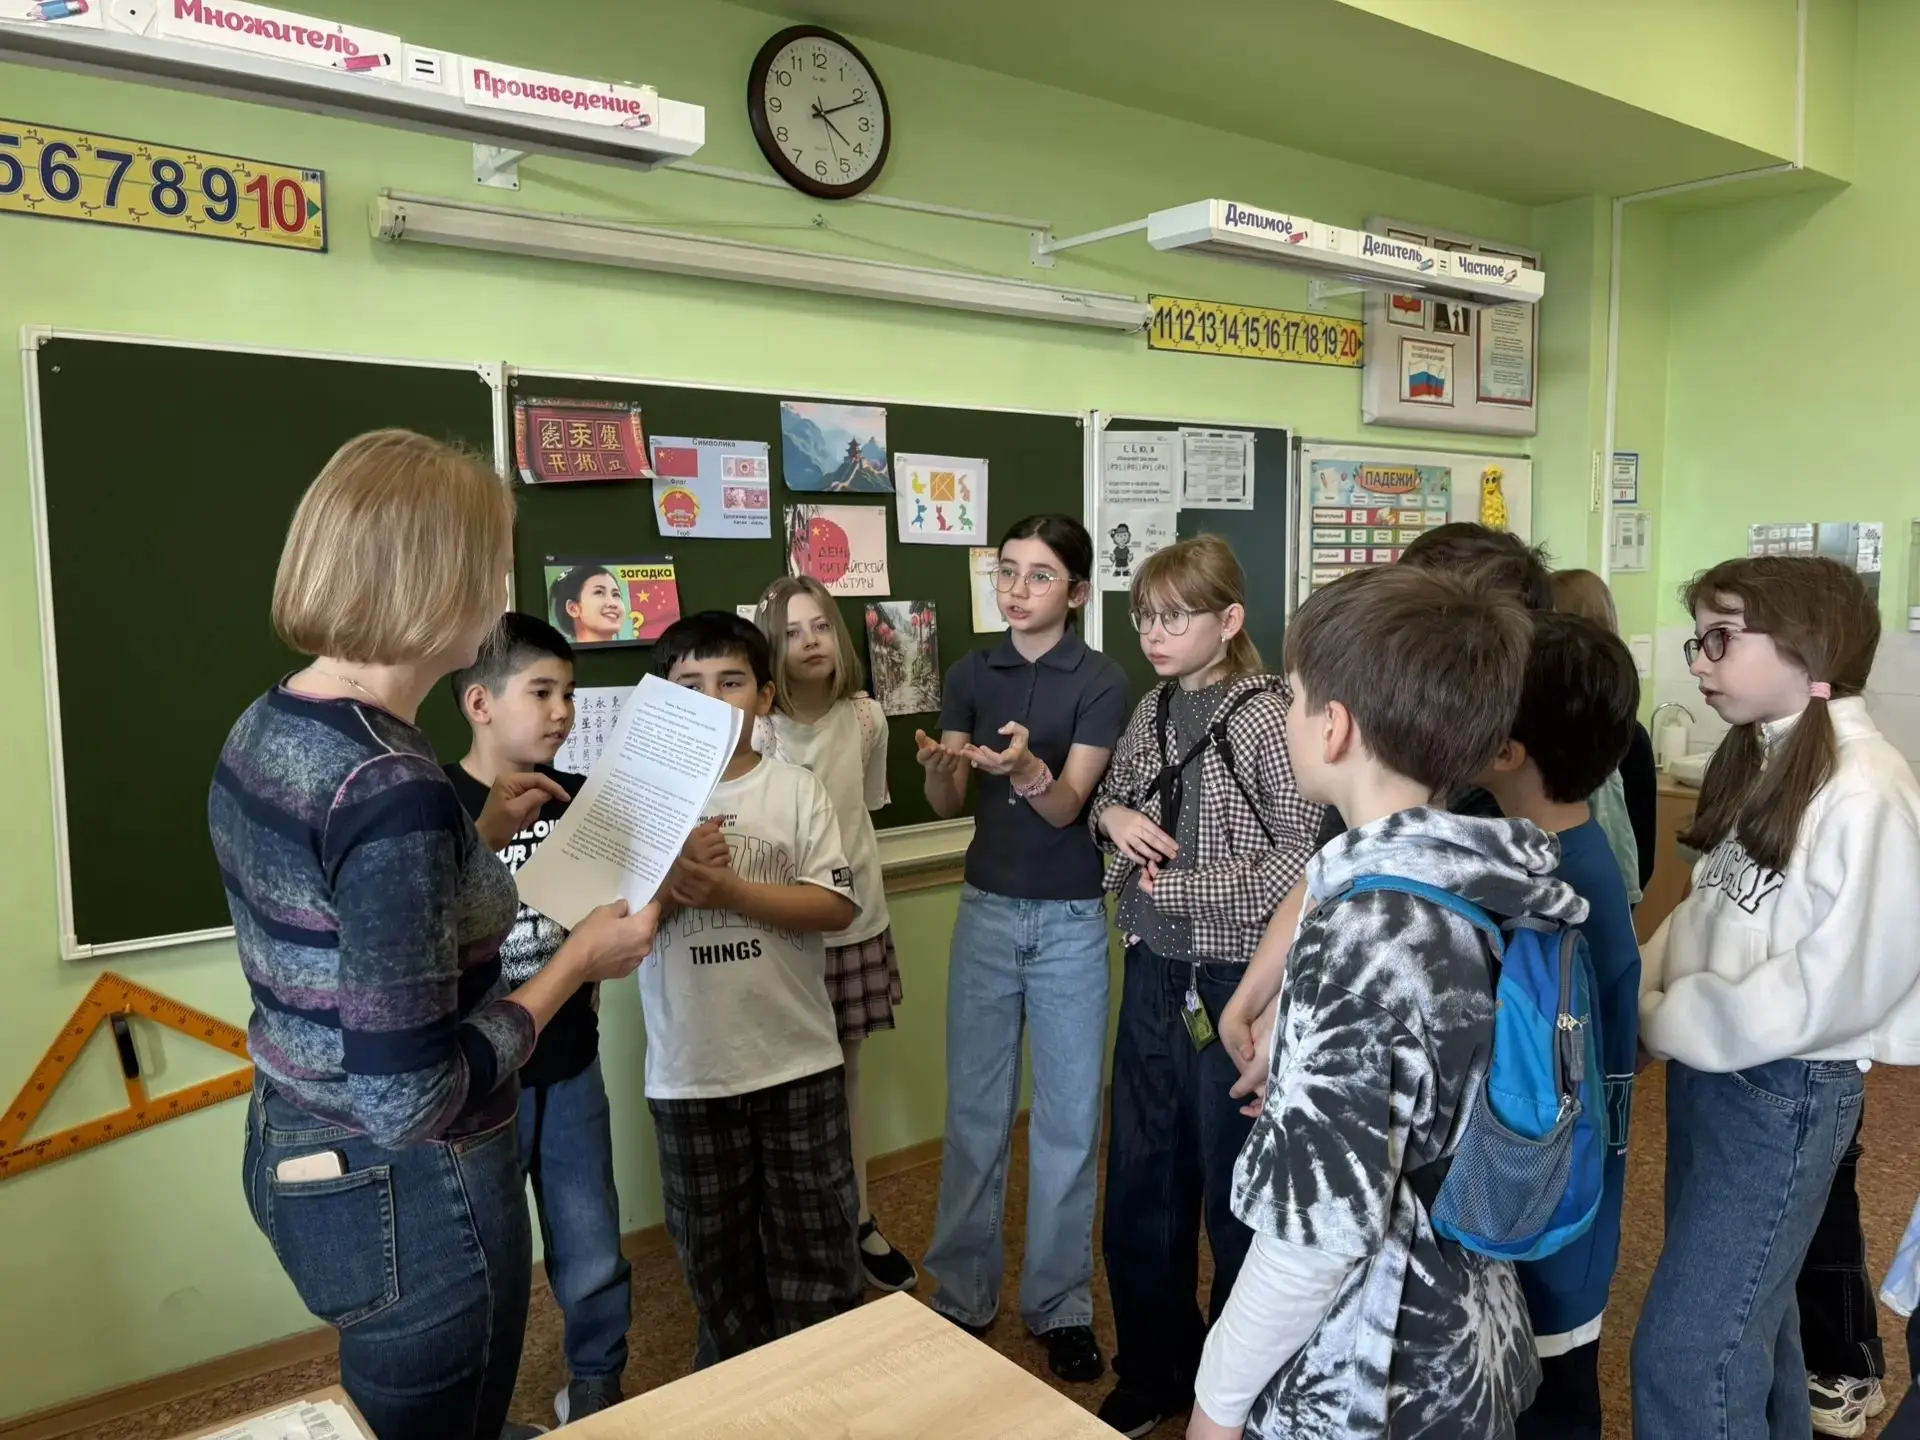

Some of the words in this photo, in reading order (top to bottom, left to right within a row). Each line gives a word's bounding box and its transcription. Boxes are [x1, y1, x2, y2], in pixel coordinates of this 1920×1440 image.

[174, 0, 359, 56] Множитель
[473, 69, 641, 115] Произведение
[791, 56, 802, 72] 11
[812, 53, 827, 70] 12
[775, 71, 792, 87] 10
[839, 68, 844, 81] 1
[852, 89, 864, 102] 2
[769, 97, 782, 112] 9
[858, 117, 870, 132] 3
[777, 127, 788, 142] 8
[791, 149, 803, 164] 7
[853, 143, 864, 157] 4
[815, 161, 827, 176] 6
[839, 158, 850, 173] 5
[41, 142, 80, 201] 6
[96, 149, 133, 206] 7
[151, 159, 187, 215] 8
[202, 167, 238, 222] 9
[246, 174, 306, 232] 10
[1225, 203, 1293, 234] Делимое
[1362, 235, 1423, 262] Делитель
[1458, 256, 1504, 277] Частное
[1156, 306, 1172, 339] 11
[1176, 309, 1195, 341] 12
[1198, 311, 1216, 343] 13
[1220, 313, 1239, 345] 14
[1242, 316, 1260, 348] 15
[1263, 319, 1280, 349] 16
[1283, 321, 1300, 351] 17
[1303, 324, 1319, 354] 18
[1322, 326, 1337, 355] 19
[1340, 328, 1357, 357] 20
[692, 439, 736, 448] Символика
[1365, 470, 1413, 488] ПАДЕЖИ
[820, 560, 884, 573] КИТАЙСКОЙ
[690, 939, 763, 966] THINGS
